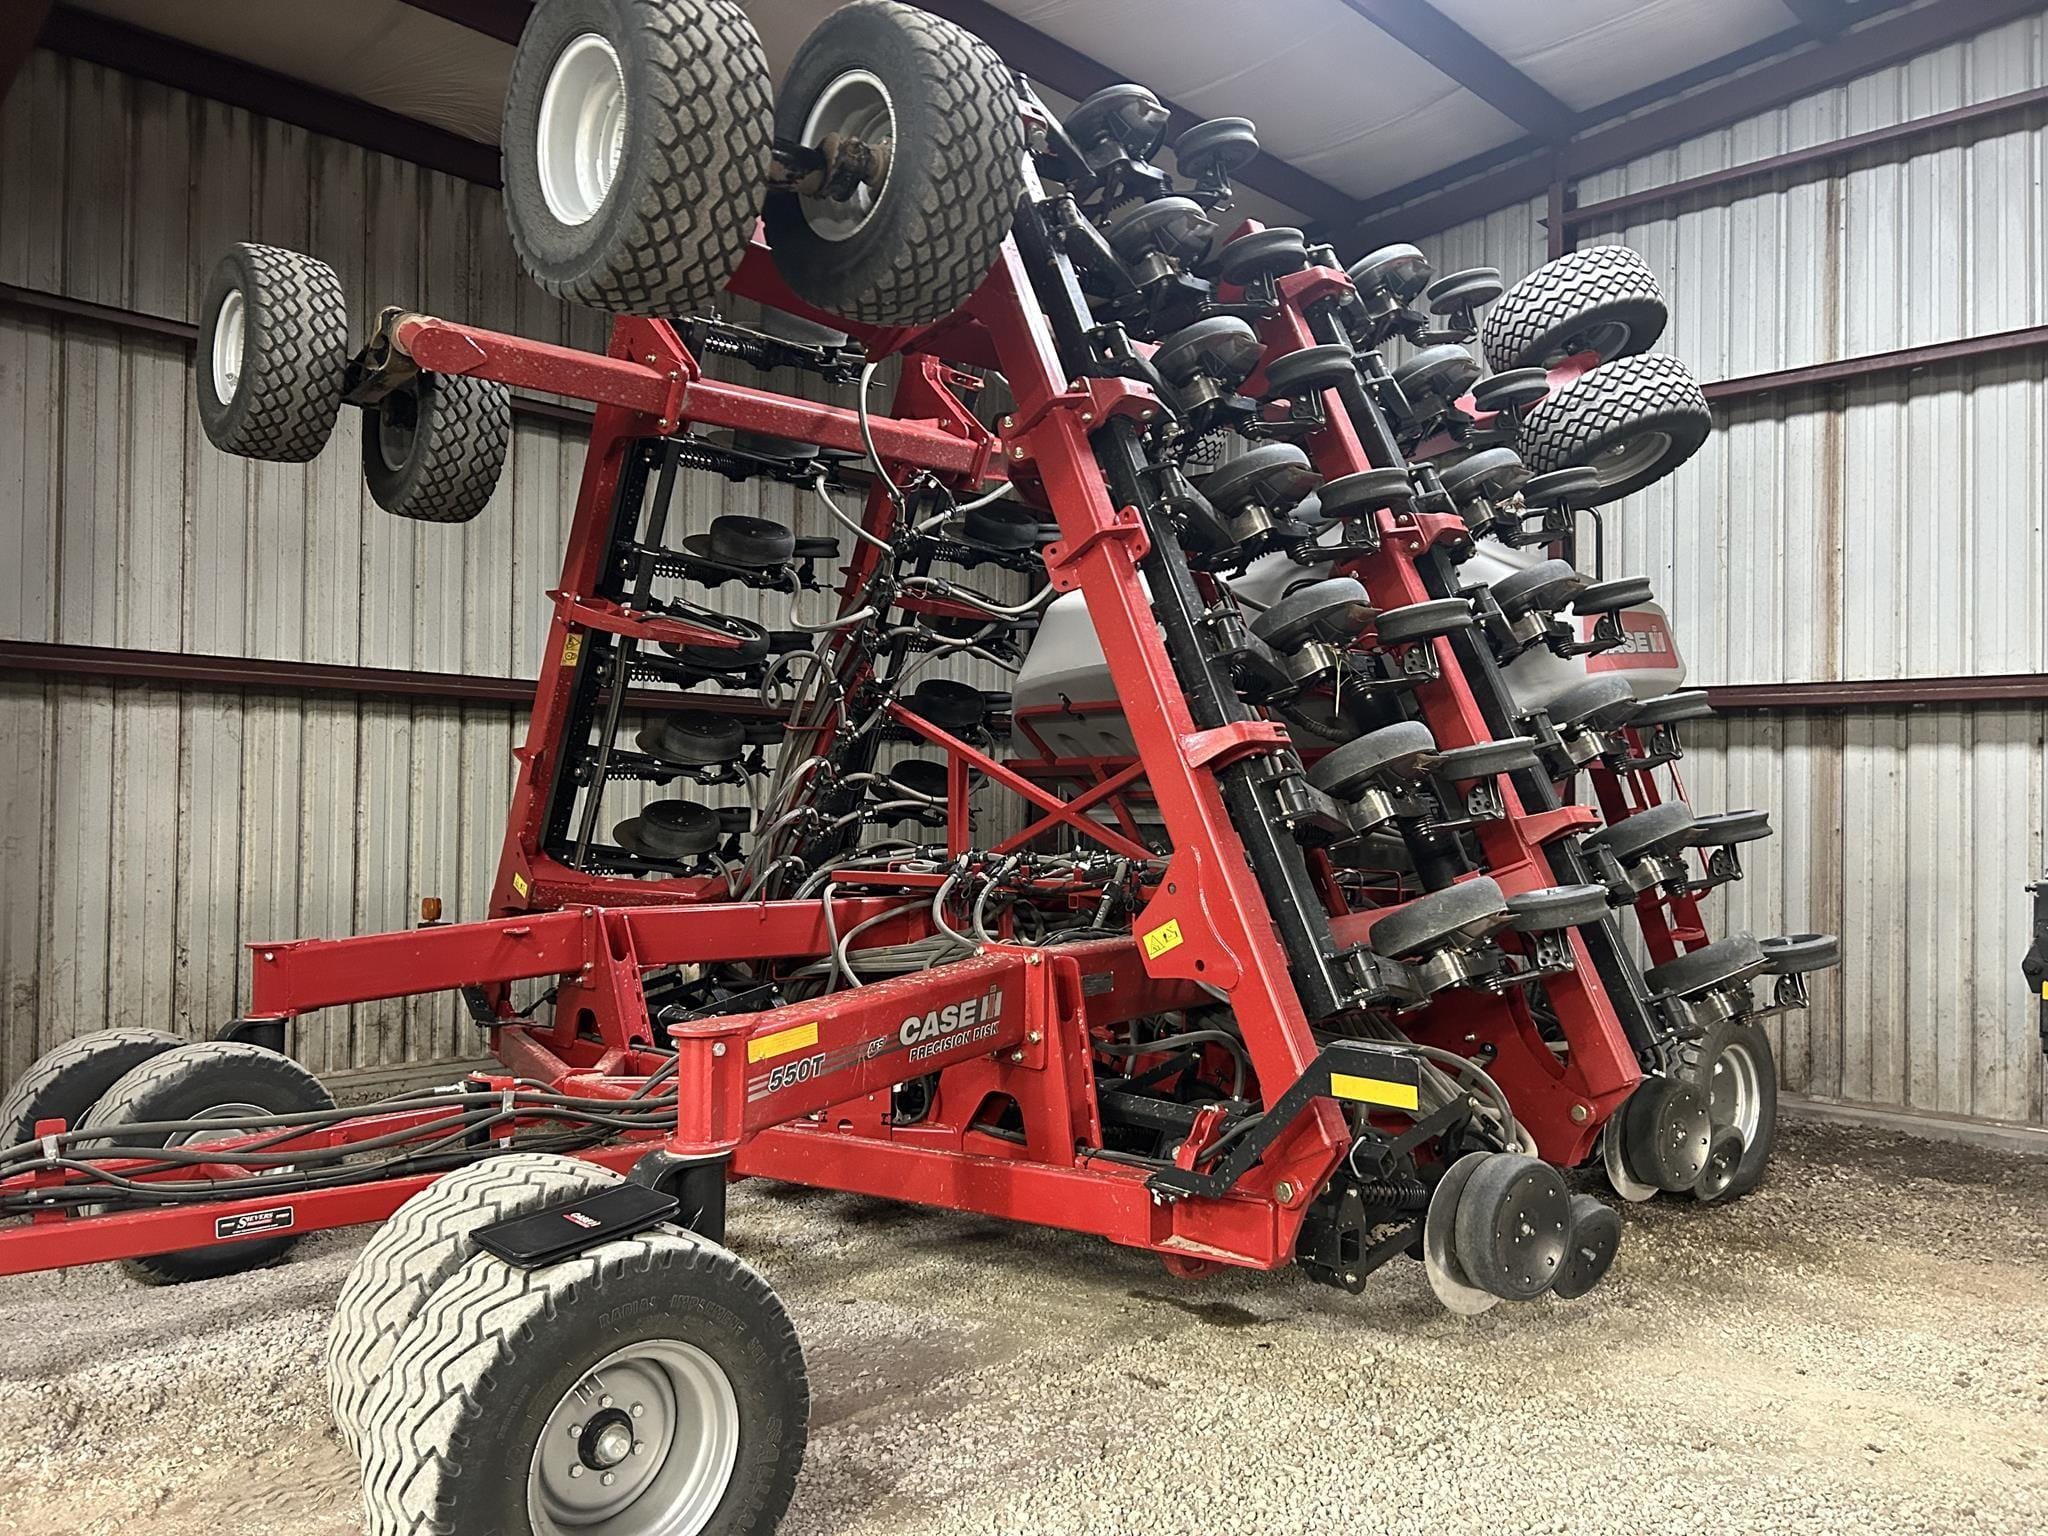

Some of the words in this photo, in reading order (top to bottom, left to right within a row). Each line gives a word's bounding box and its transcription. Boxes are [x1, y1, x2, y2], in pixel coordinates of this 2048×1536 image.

[899, 998, 978, 1046] CASE
[909, 1030, 972, 1063] PRECISION
[972, 1020, 1001, 1042] DISK
[867, 1034, 888, 1059] AFS
[767, 1052, 826, 1093] 550T
[598, 1295, 657, 1328] RADIAL
[670, 1294, 747, 1335] IMPLEMENT
